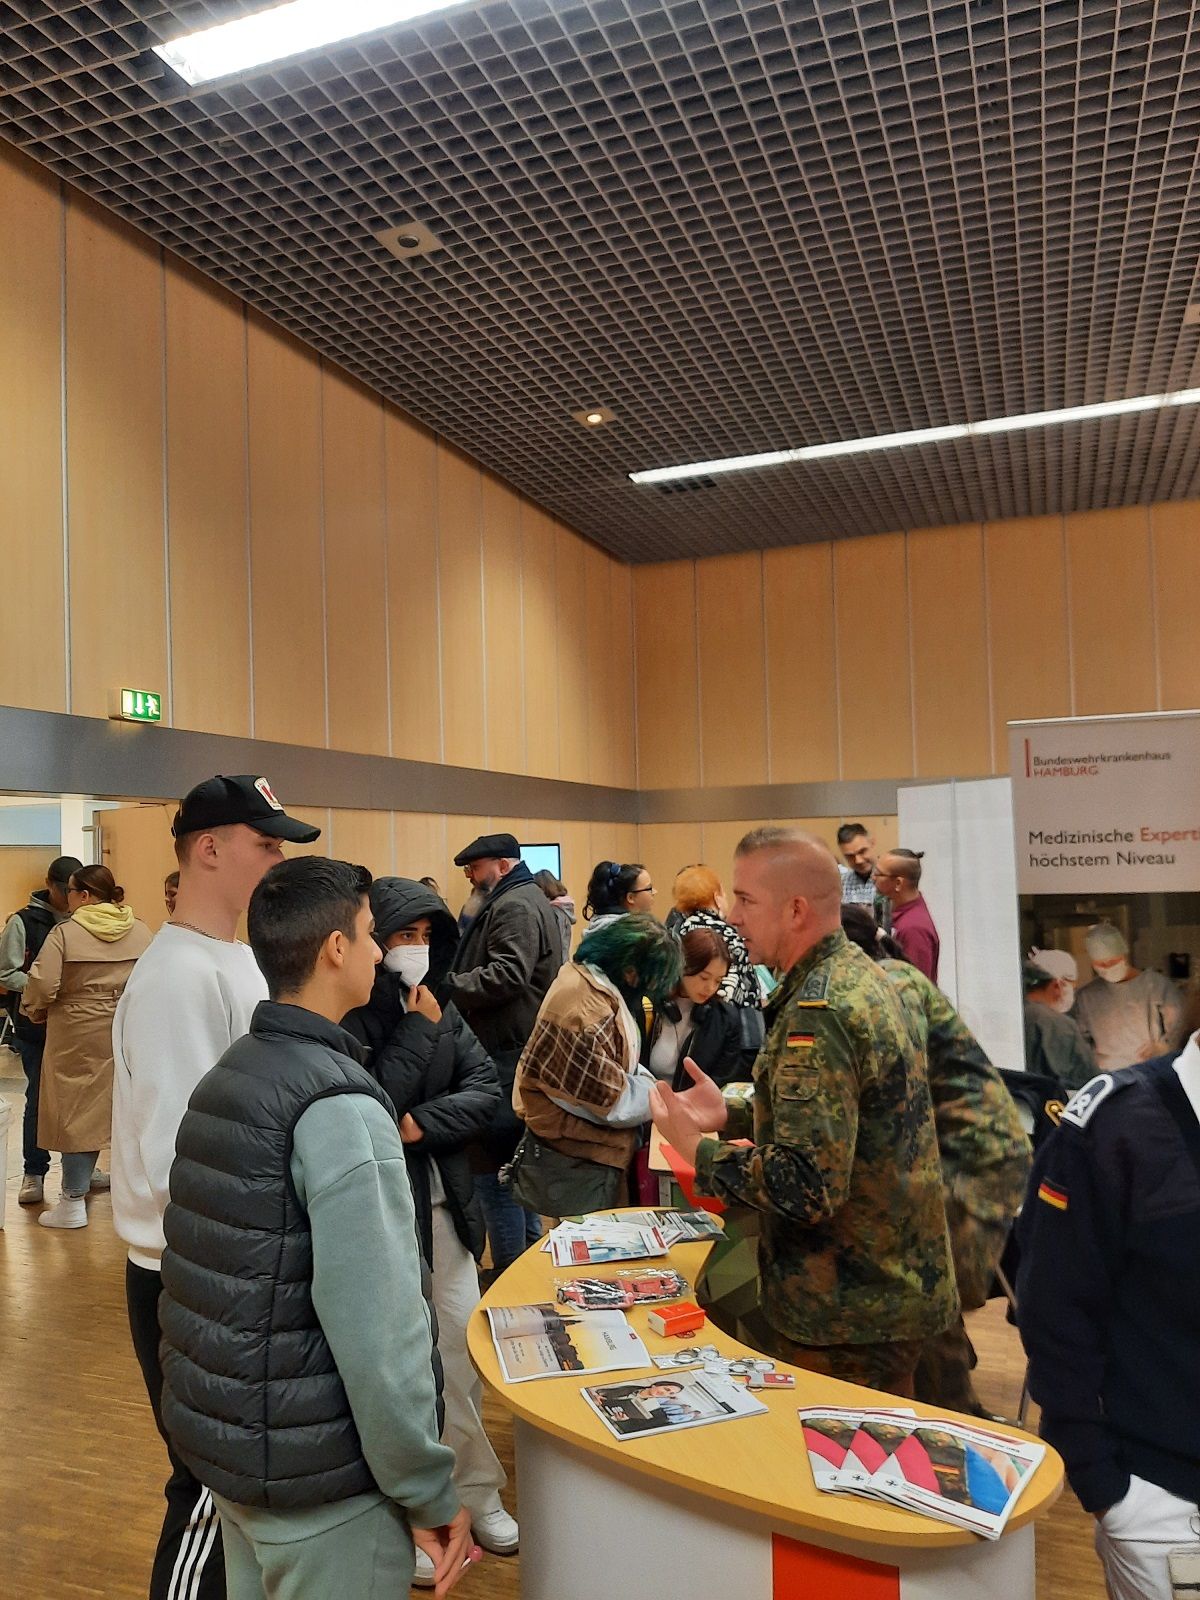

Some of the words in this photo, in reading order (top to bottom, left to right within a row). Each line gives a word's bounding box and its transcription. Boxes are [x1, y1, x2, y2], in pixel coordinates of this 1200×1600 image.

[1033, 751, 1171, 766] Bundeswehrkrankenhaus
[1033, 765, 1099, 777] HAMBURG
[1028, 828, 1134, 845] Medizinische
[1029, 854, 1110, 868] höchstem
[1116, 851, 1176, 865] Niveau
